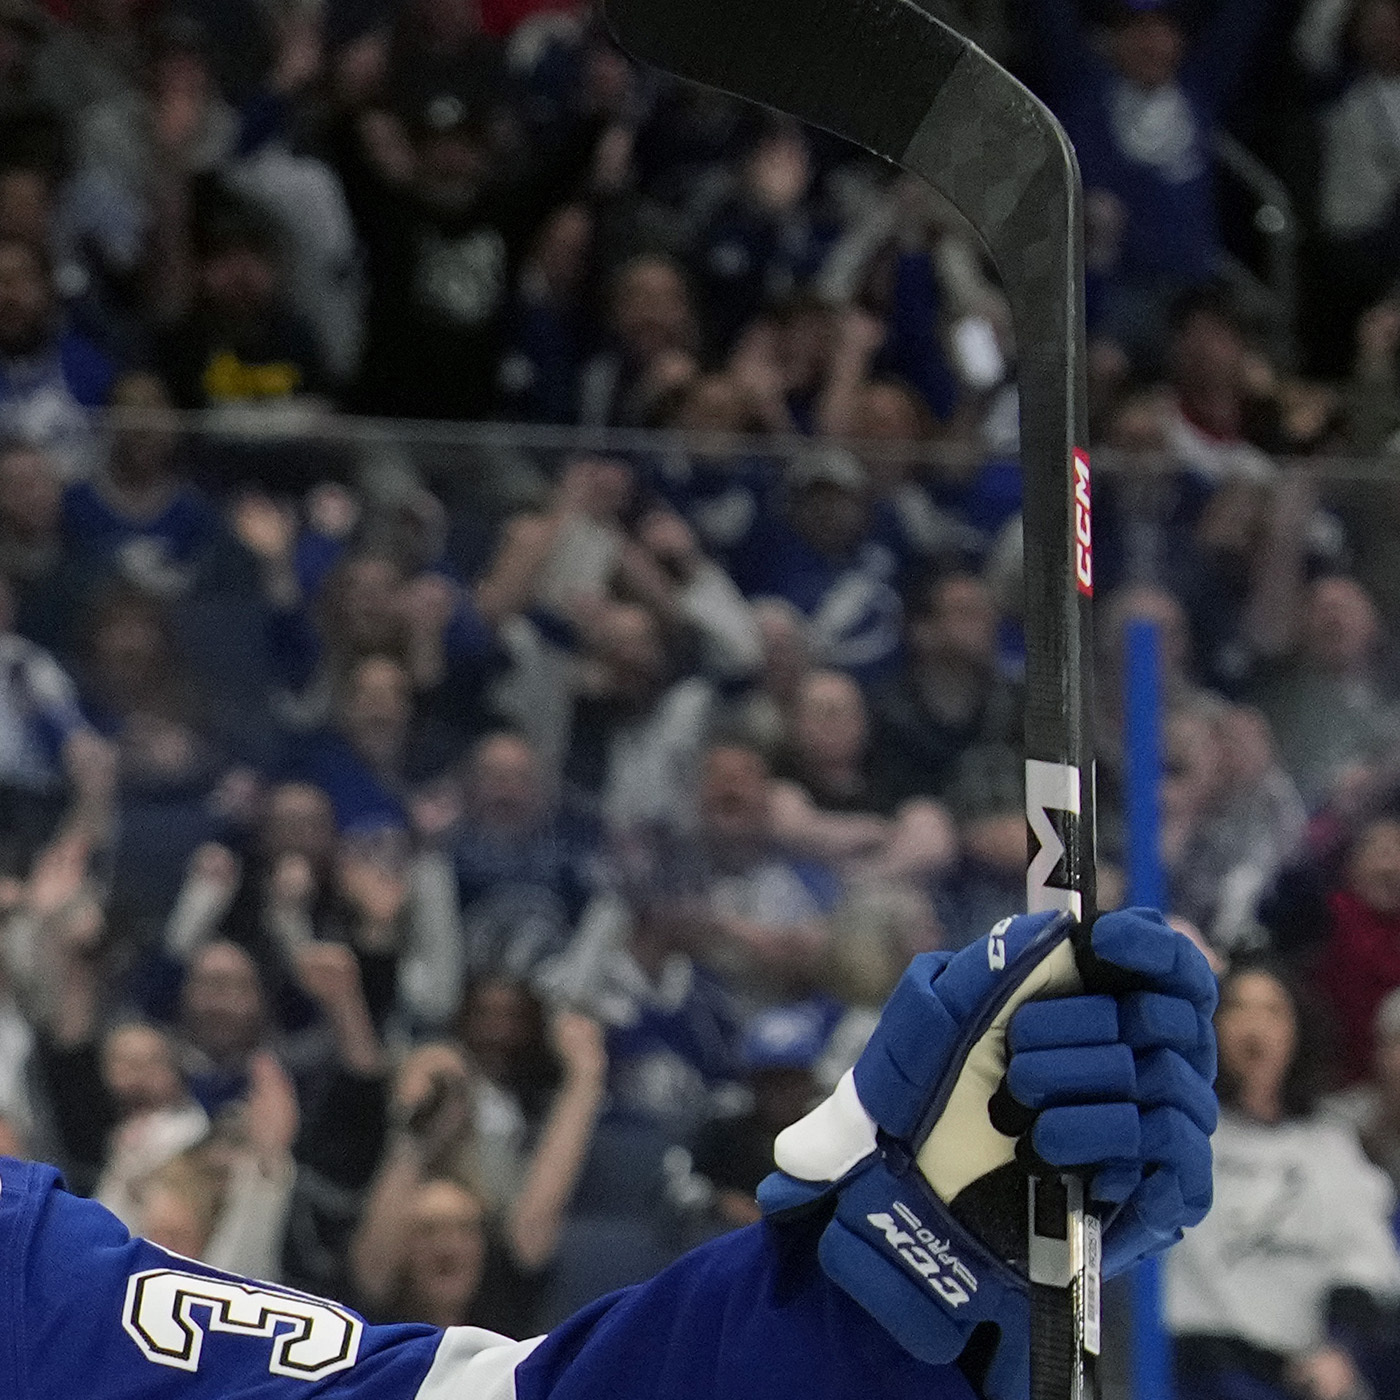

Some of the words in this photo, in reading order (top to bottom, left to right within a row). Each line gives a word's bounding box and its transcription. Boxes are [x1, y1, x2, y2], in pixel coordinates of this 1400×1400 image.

[1075, 457, 1093, 587] CCM
[988, 914, 1019, 971] CC
[866, 1212, 970, 1309] CCM
